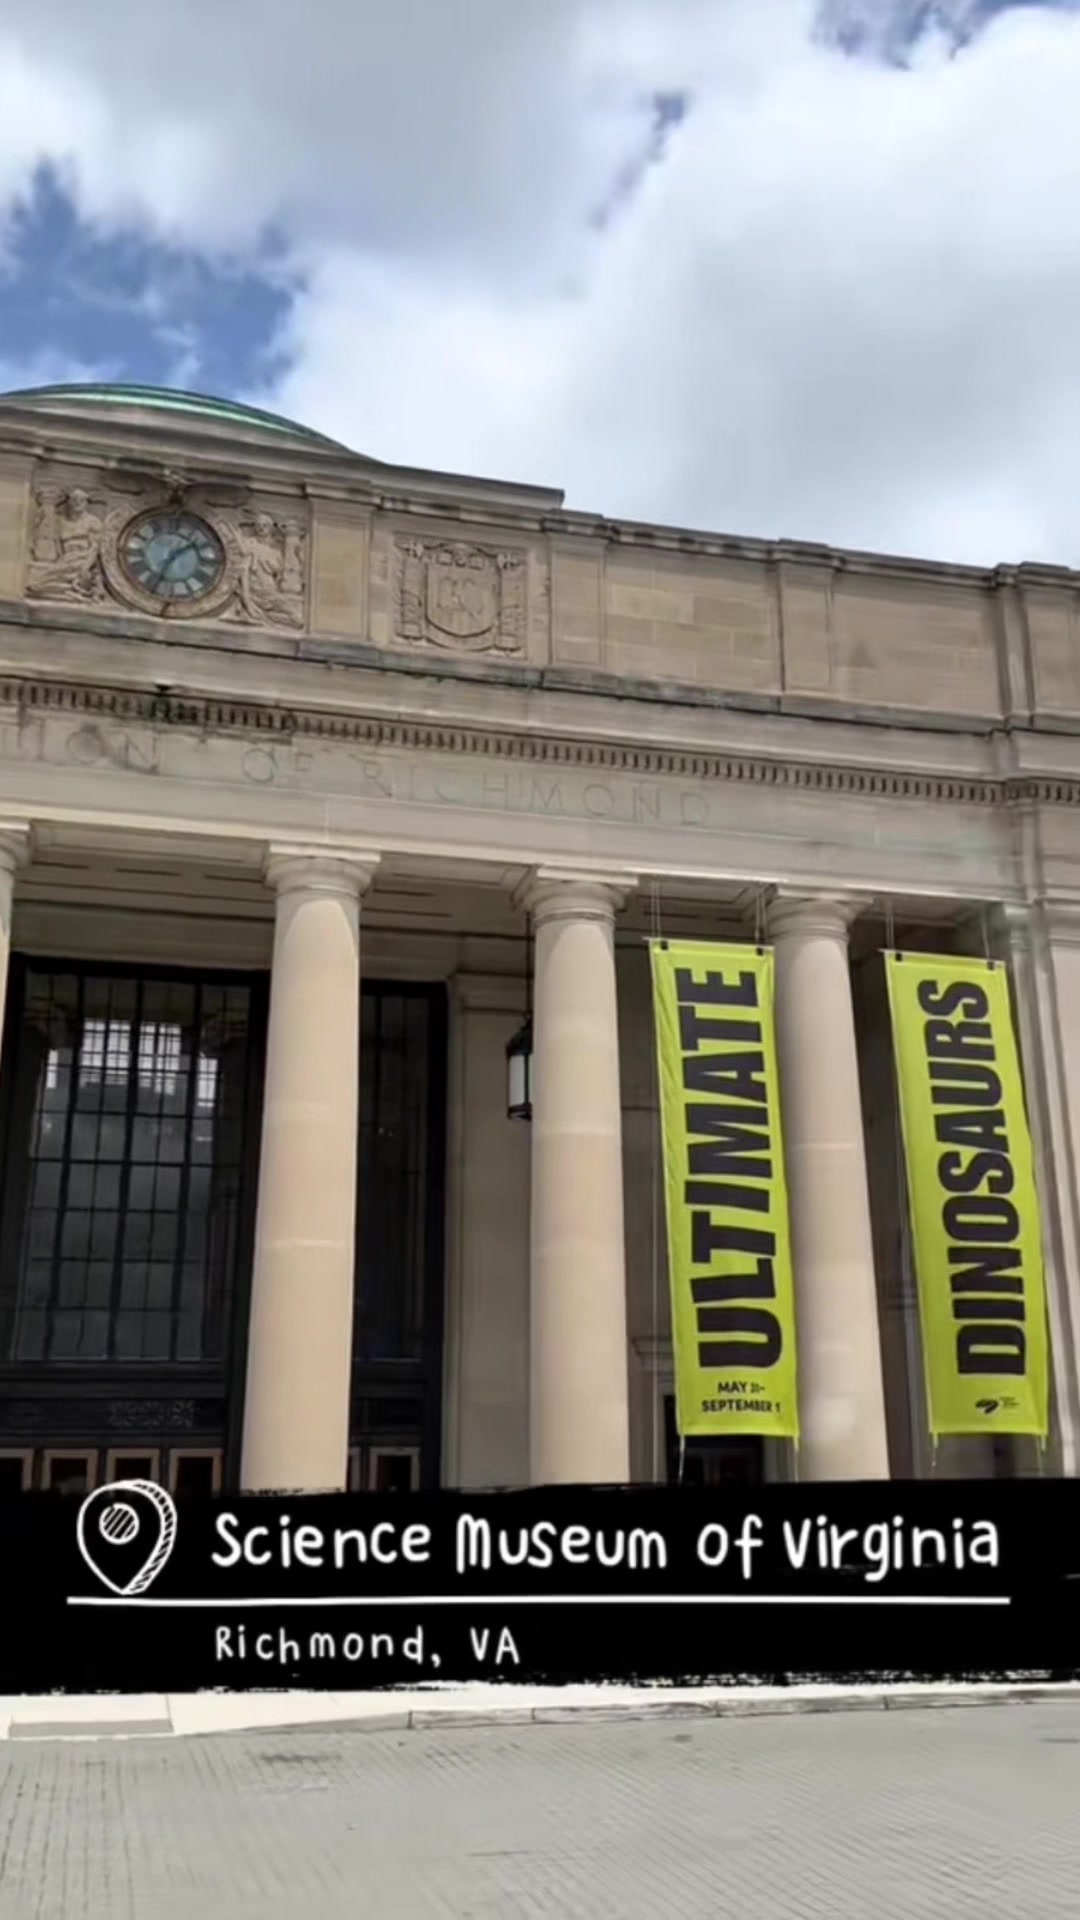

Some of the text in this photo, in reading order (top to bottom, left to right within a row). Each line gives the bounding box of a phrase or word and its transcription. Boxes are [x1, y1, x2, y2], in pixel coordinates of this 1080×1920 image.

[242, 746, 313, 783] OF
[360, 758, 712, 826] RICHMOND
[674, 967, 783, 1368] ULTIMATE
[917, 979, 1027, 1376] DINOSAURS
[701, 1399, 773, 1413] SEPTEMBER
[717, 1381, 748, 1393] MAY
